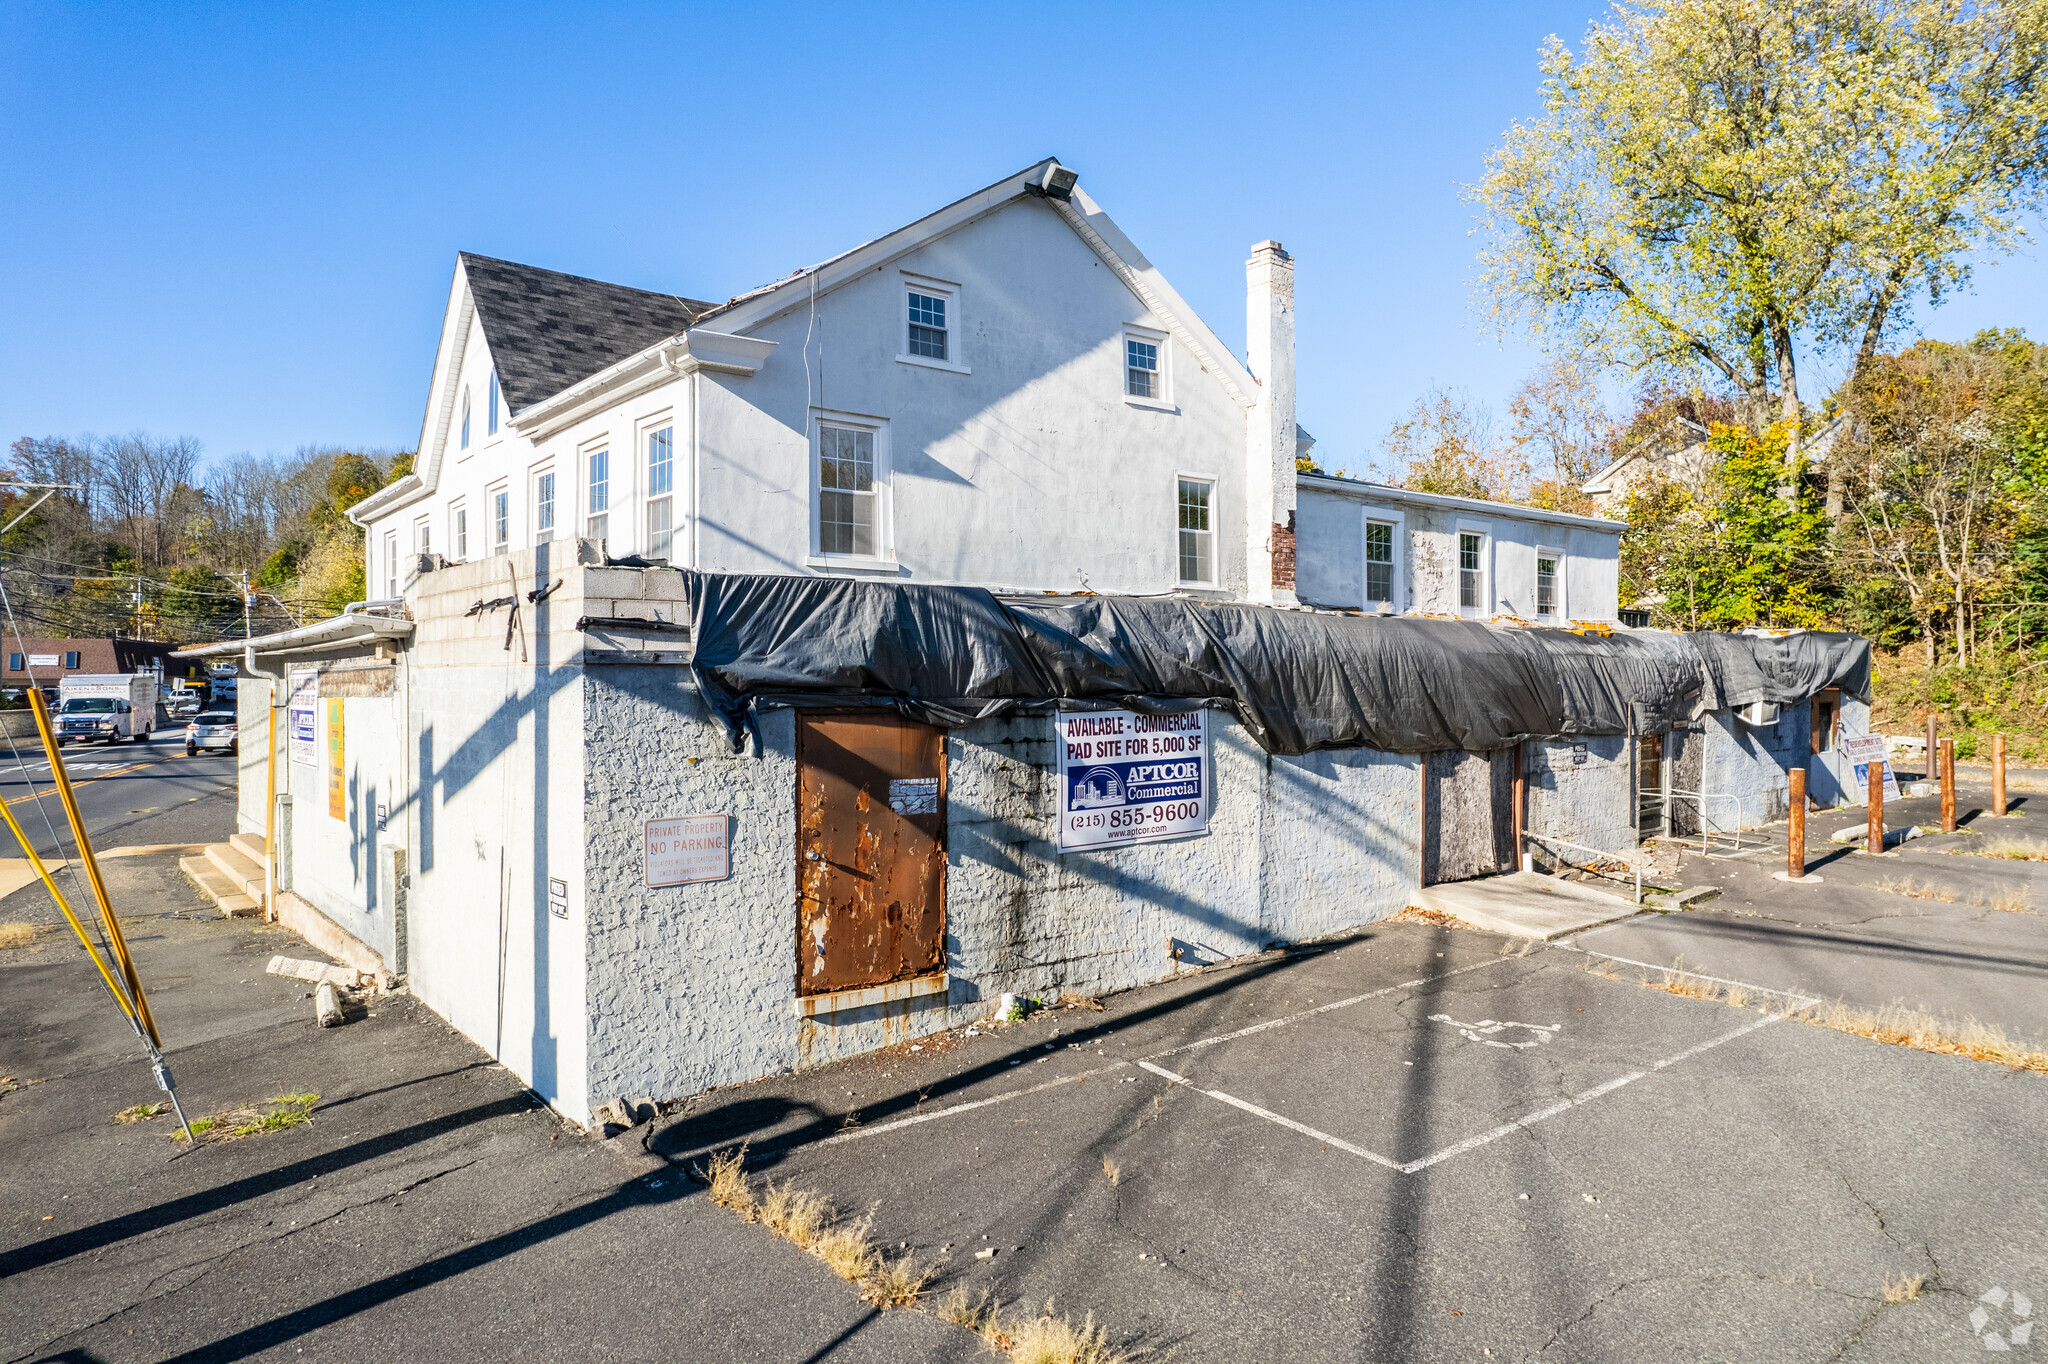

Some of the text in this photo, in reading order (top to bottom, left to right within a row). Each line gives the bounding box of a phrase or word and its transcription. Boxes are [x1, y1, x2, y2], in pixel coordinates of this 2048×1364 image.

[1068, 716, 1124, 737] AVAILABLE
[1134, 713, 1201, 733] COMMERCIAL
[1067, 735, 1201, 760] PAD SITE FOR 5,000 SF
[1127, 762, 1199, 782] APTCOR
[1127, 783, 1198, 800] Commercial
[1071, 802, 1199, 830] (215) 855-9600
[650, 823, 723, 838] PRIVATE PROPERTY
[1108, 824, 1167, 839] www.aptcor.com
[651, 837, 722, 854] NO PARKING
